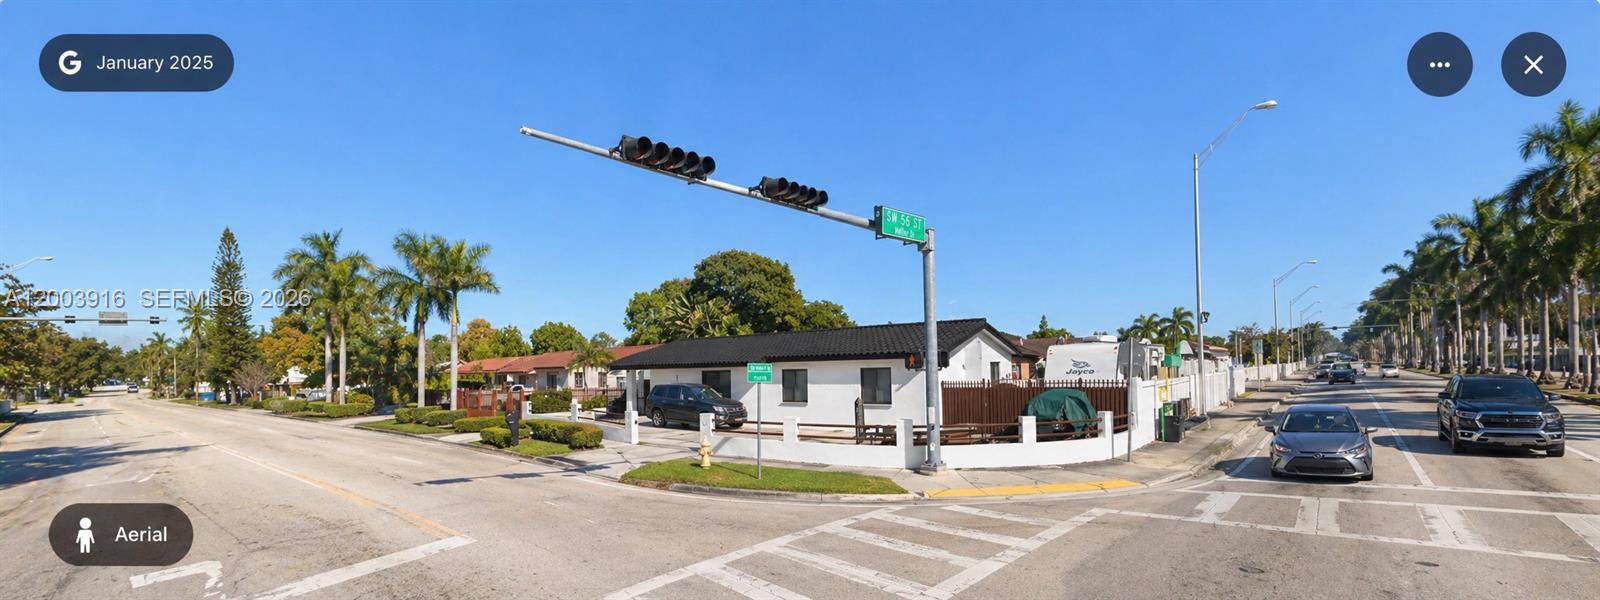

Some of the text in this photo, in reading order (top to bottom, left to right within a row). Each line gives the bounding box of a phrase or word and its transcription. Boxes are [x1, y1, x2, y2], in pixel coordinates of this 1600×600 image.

[886, 210, 922, 229] SW 56 ST
